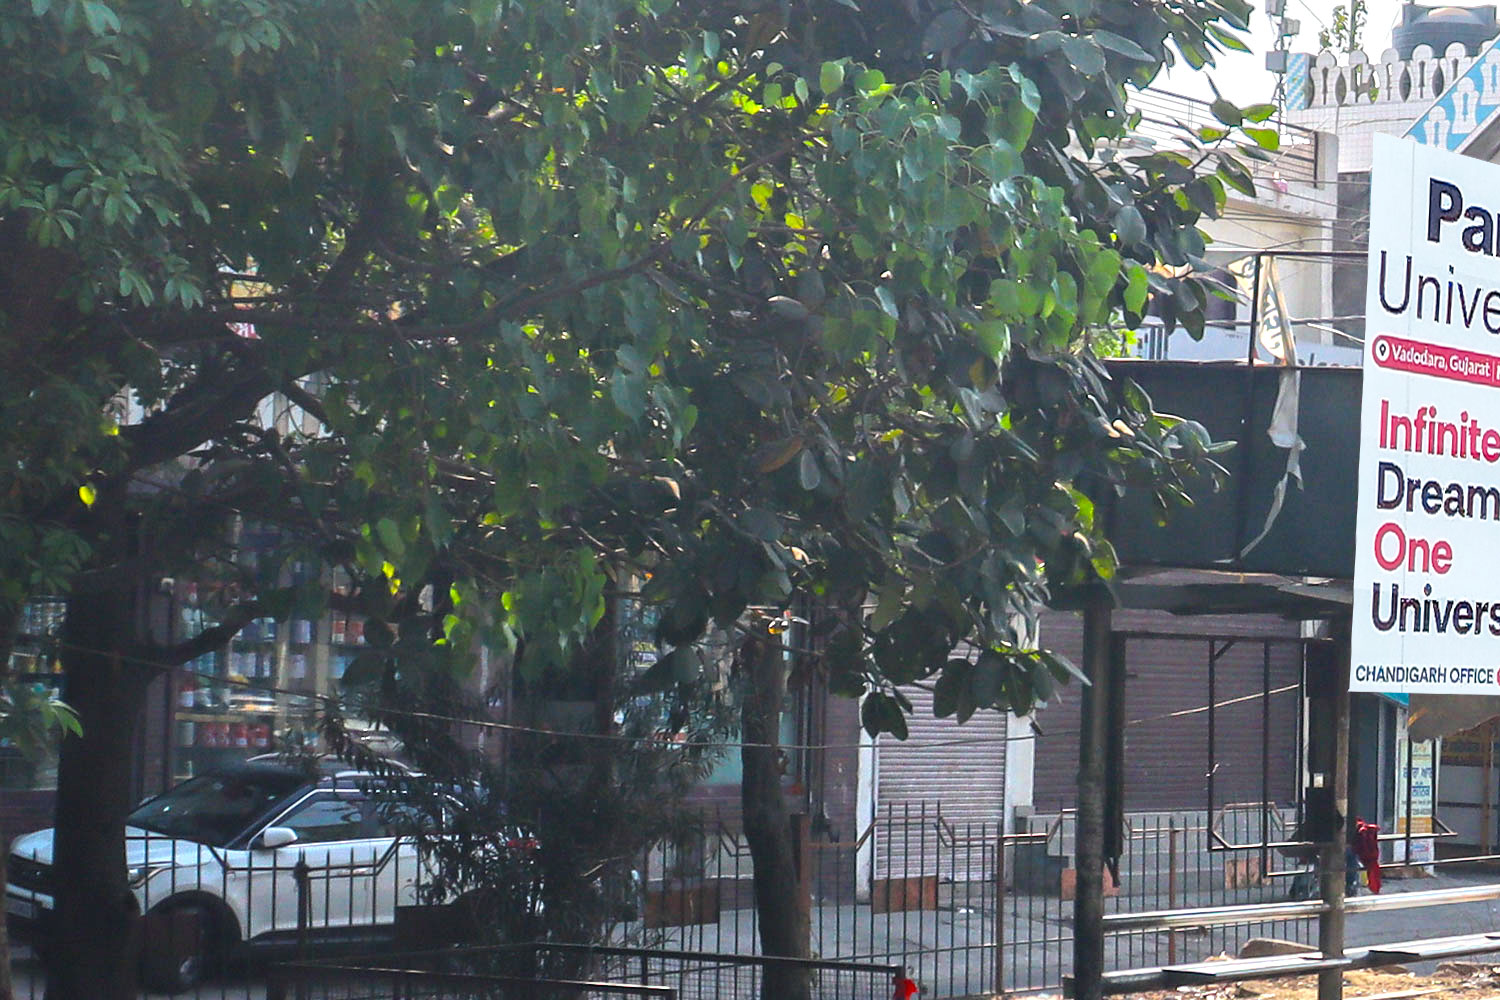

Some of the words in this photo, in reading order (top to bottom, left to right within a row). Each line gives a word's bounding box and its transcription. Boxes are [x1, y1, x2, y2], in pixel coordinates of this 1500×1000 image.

[1391, 344, 1448, 371] Vadodara,
[1450, 356, 1491, 378] Gujarat
[1374, 522, 1453, 574] One
[1356, 664, 1447, 684] CHANDIGARH
[1449, 667, 1494, 685] OFFICE
